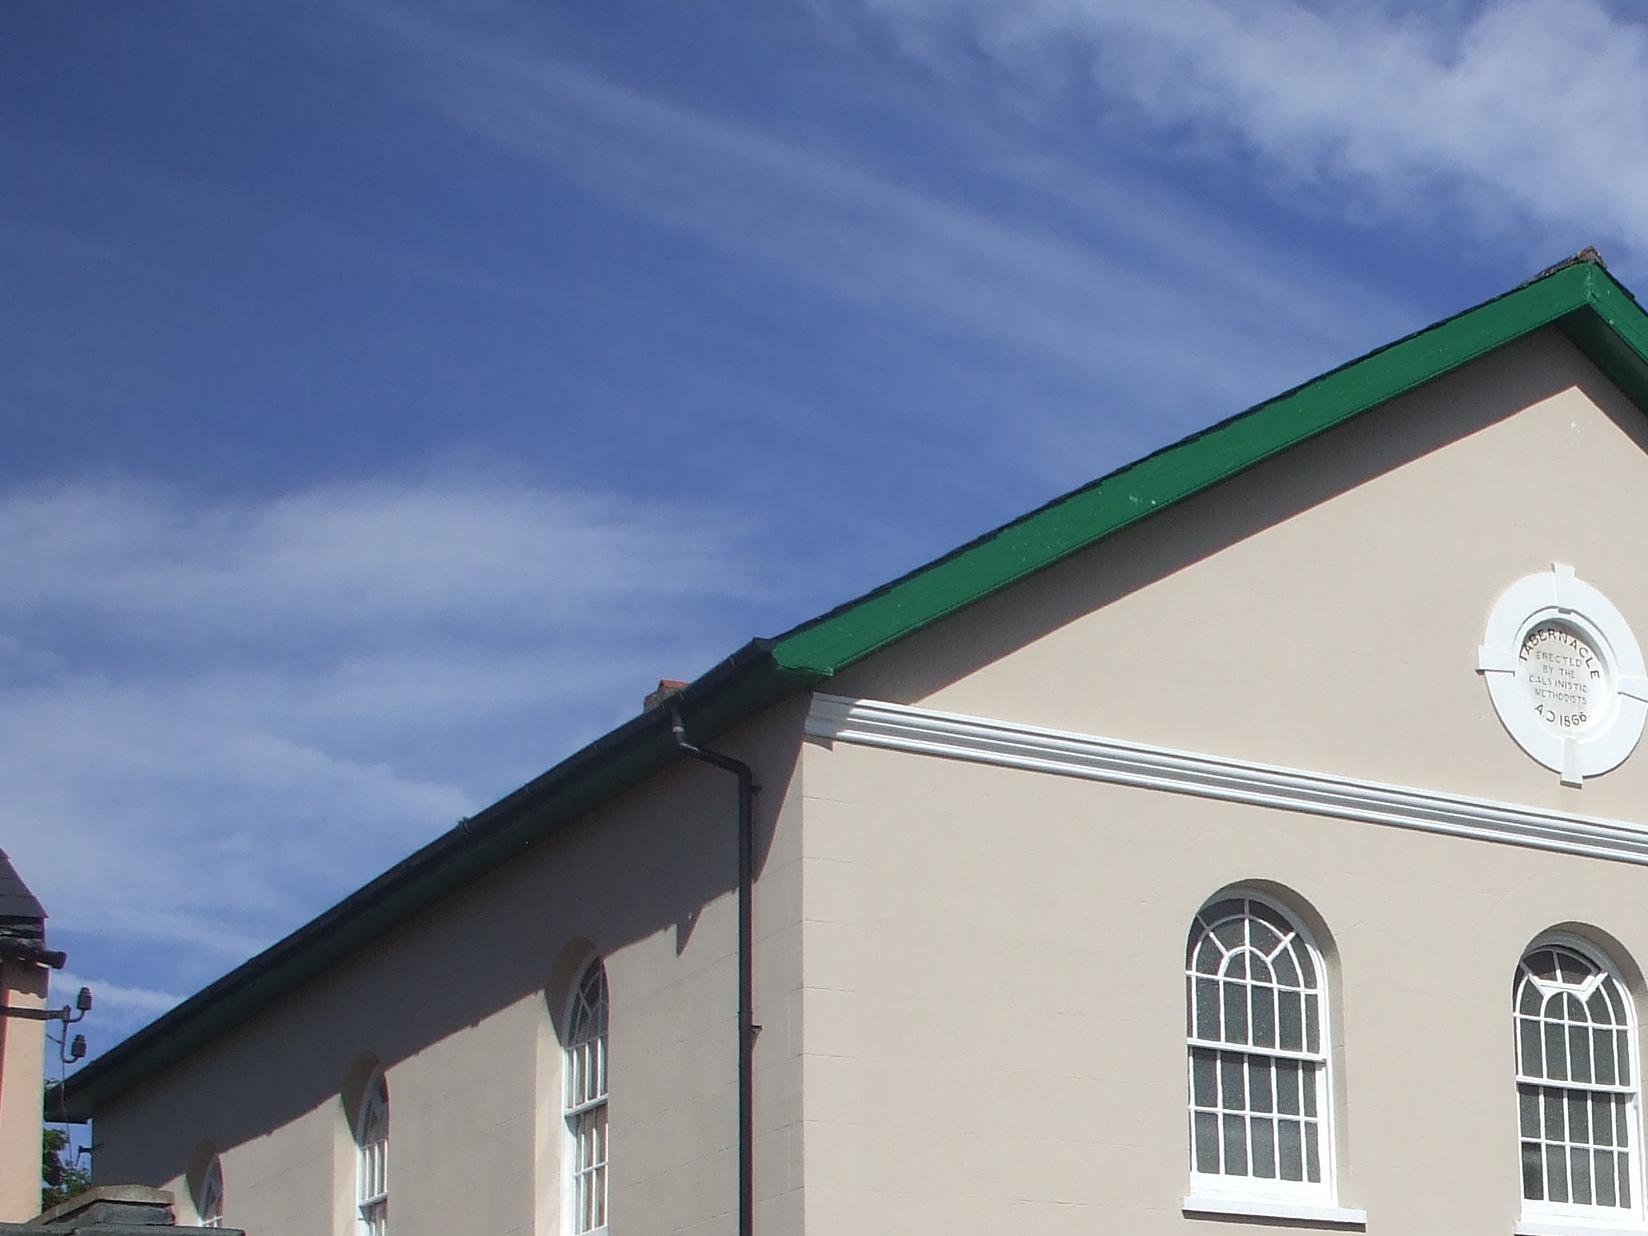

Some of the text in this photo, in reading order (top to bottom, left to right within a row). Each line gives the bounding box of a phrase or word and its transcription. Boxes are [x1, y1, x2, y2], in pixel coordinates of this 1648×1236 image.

[1519, 628, 1600, 679] TABERNACLE
[1537, 651, 1582, 667] ERECTED
[1542, 665, 1576, 678] BY THE
[1529, 675, 1588, 693] CALVINISTIC
[1535, 688, 1587, 705] METHODISTS
[1560, 711, 1587, 727] 1866
